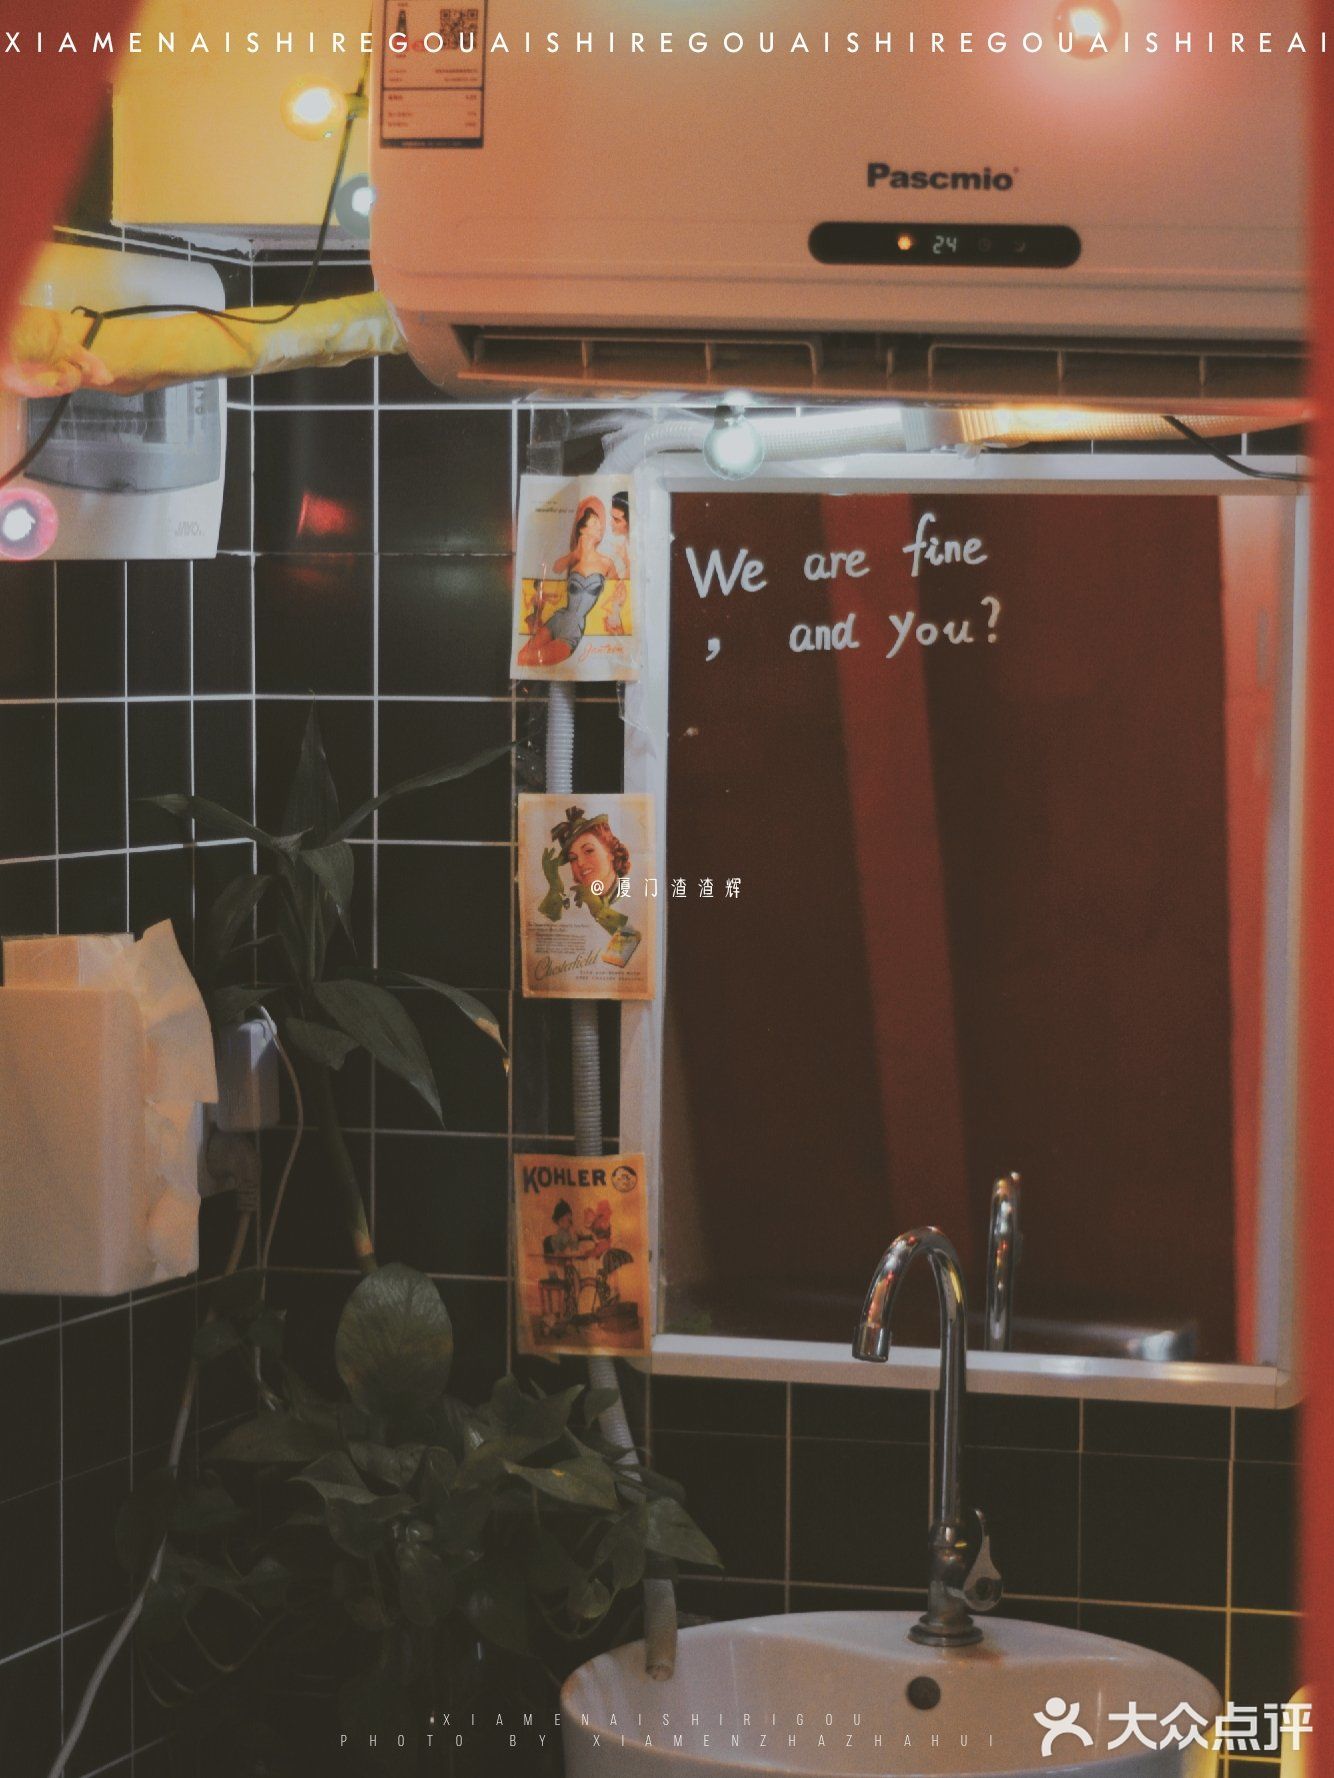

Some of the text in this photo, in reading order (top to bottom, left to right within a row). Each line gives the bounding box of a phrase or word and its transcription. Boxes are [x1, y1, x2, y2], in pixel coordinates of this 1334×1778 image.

[866, 162, 1013, 191] Pascmio
[932, 235, 958, 254] 24
[685, 511, 989, 599] We are fine
[788, 613, 861, 653] and
[886, 596, 1001, 659] you?
[534, 949, 602, 981] Chesterfield
